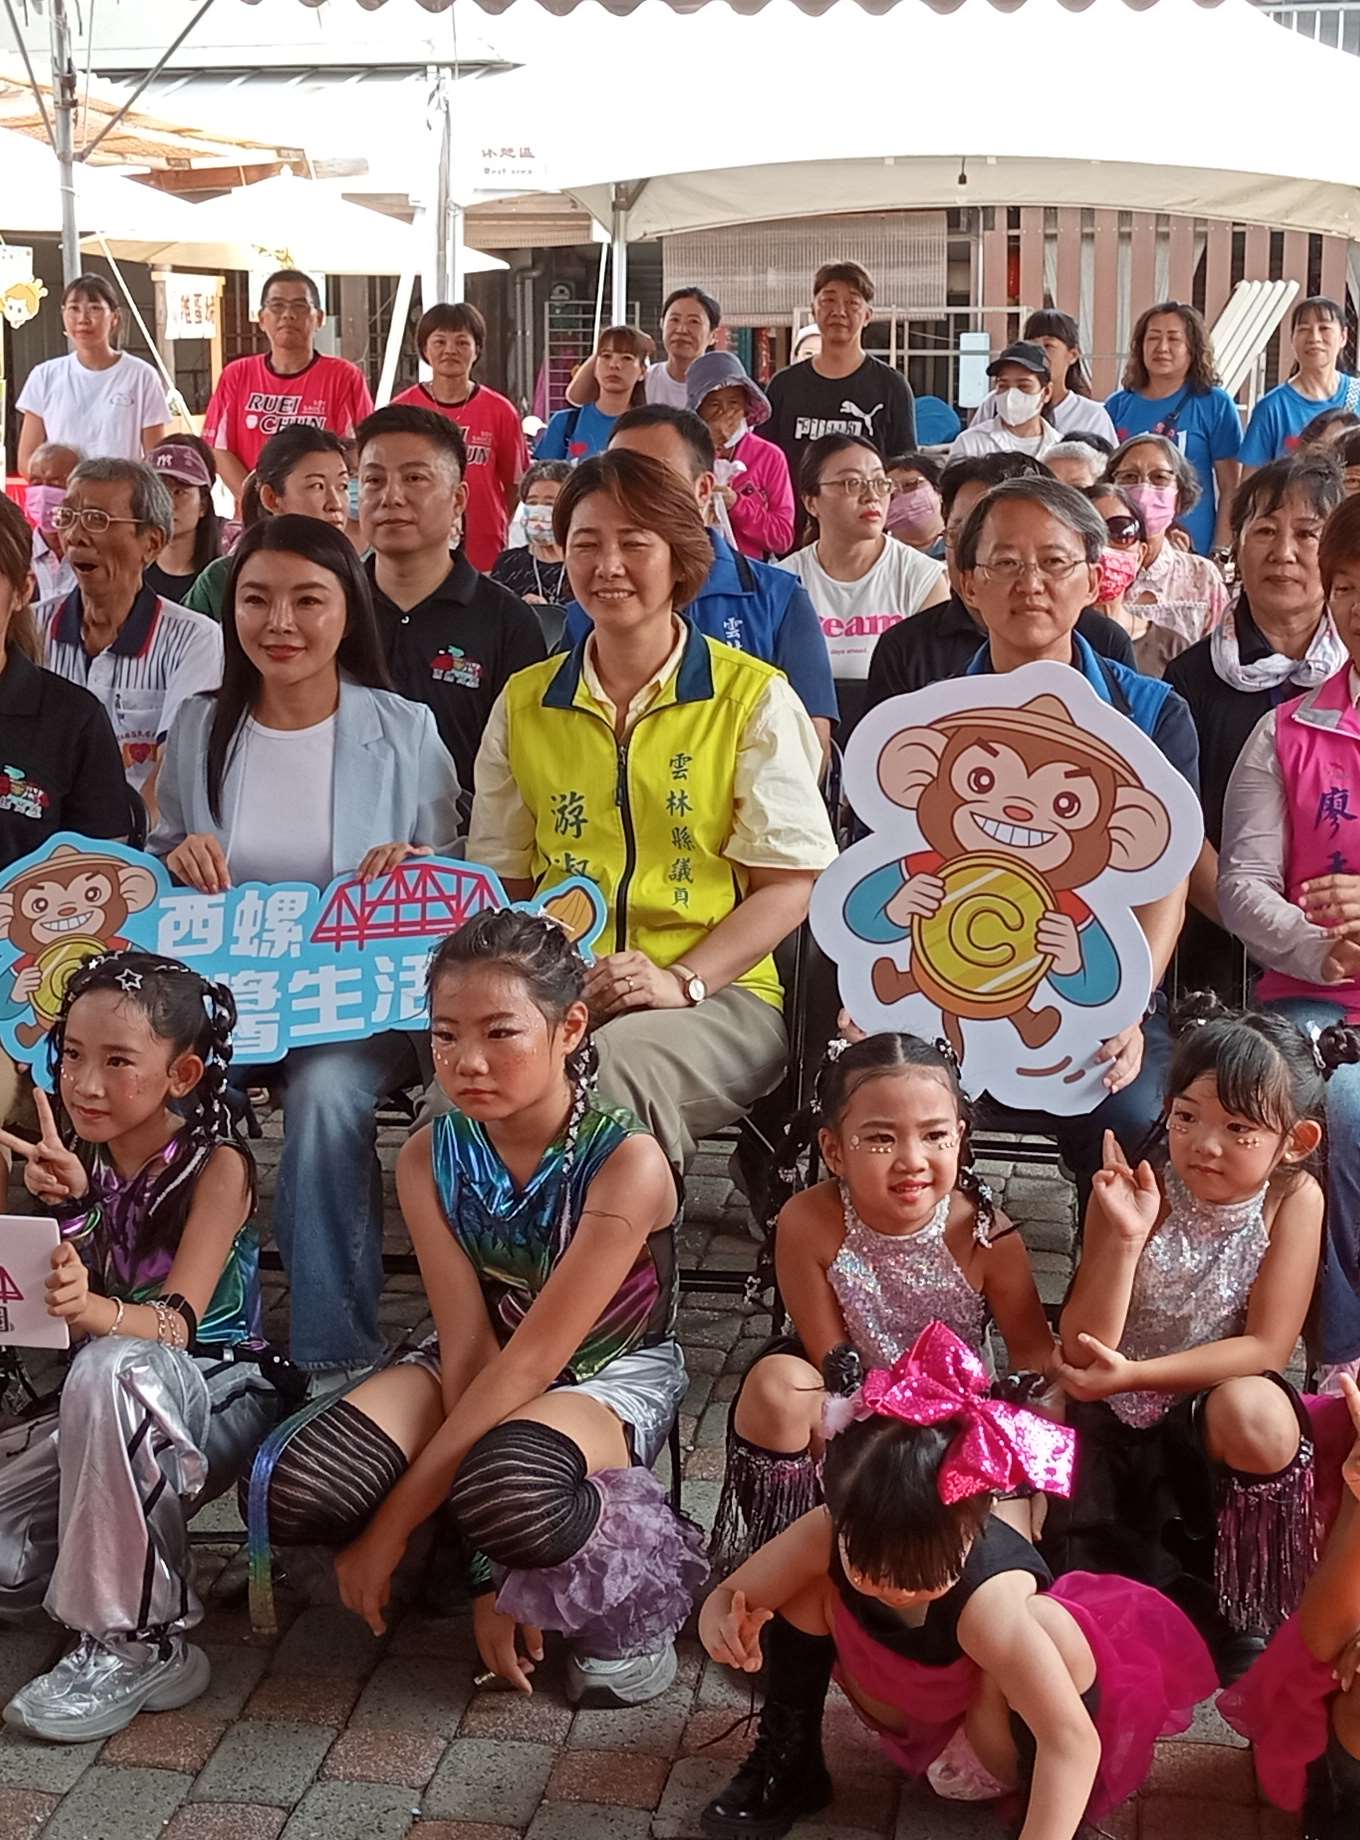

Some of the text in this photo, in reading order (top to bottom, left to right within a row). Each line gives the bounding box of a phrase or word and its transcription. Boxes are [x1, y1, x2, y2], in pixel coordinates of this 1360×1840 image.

[245, 392, 302, 414] RUEI
[794, 417, 863, 441] PUMA
[666, 753, 695, 908] 雲林縣議員
[158, 890, 308, 959] 西螺
